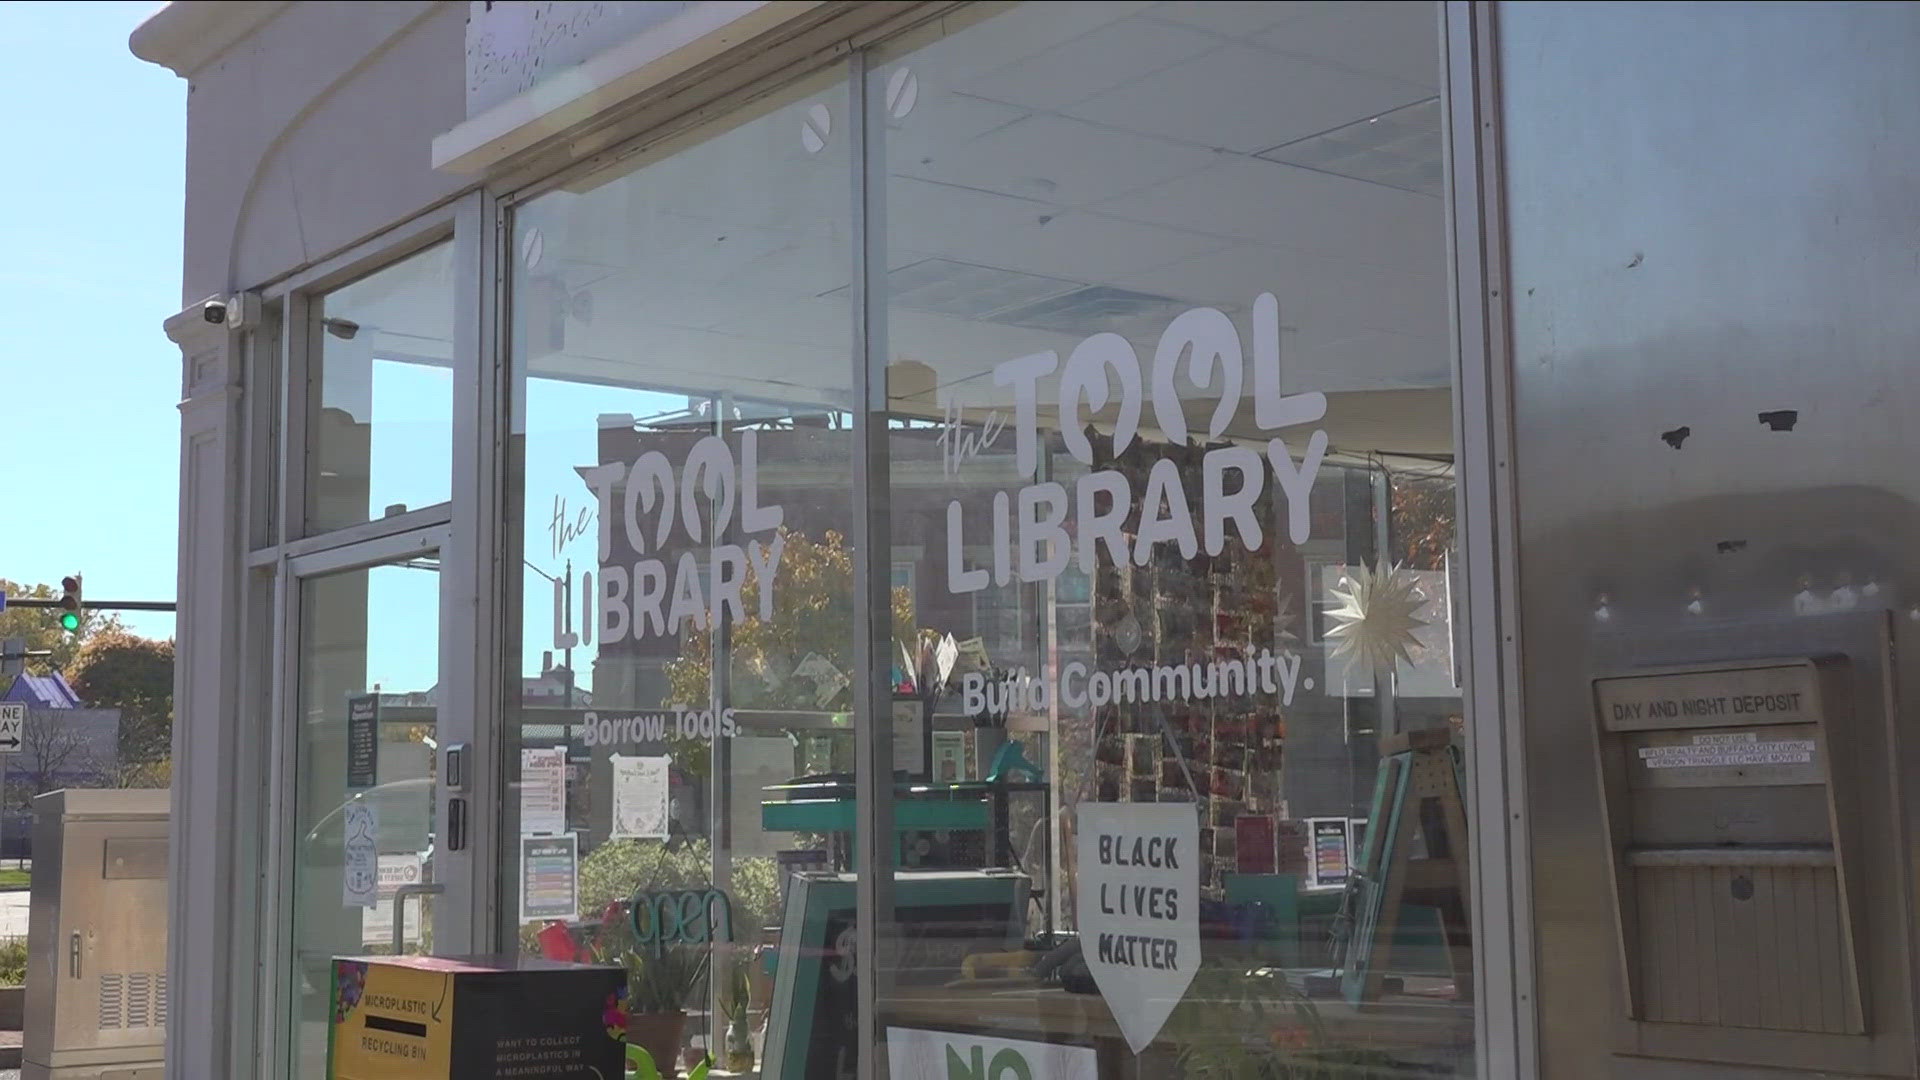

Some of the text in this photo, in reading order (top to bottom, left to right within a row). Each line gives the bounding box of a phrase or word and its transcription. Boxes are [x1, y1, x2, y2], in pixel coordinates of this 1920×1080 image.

[936, 292, 1327, 481] the TOOL
[548, 428, 784, 563] the TOOL
[947, 429, 1328, 594] LIBRARY
[553, 533, 784, 650] LIBRARY
[963, 644, 1314, 717] Build Community.
[0, 707, 20, 720] NE
[583, 700, 743, 747] Borrow Tools.
[1613, 693, 1801, 721] DAY AND NIGHT DEPOSIT
[0, 721, 20, 733] AY
[1713, 735, 1729, 743] NOT
[1757, 743, 1776, 751] CITY
[1778, 742, 1807, 750] LIVING
[1099, 834, 1179, 869] BLACK
[1100, 883, 1178, 920] LIVES
[631, 889, 734, 960] open
[1098, 933, 1178, 971] MATTER
[365, 994, 426, 1014] MICROPLASTIC
[362, 1036, 427, 1060] RECYCLING BIN
[496, 1036, 581, 1048] WANT TO COLLECT
[496, 1049, 581, 1062] MICROPLASTICS IN
[496, 1063, 584, 1076] A MEANINGFUL WAY
[945, 1042, 1033, 1080] NO
